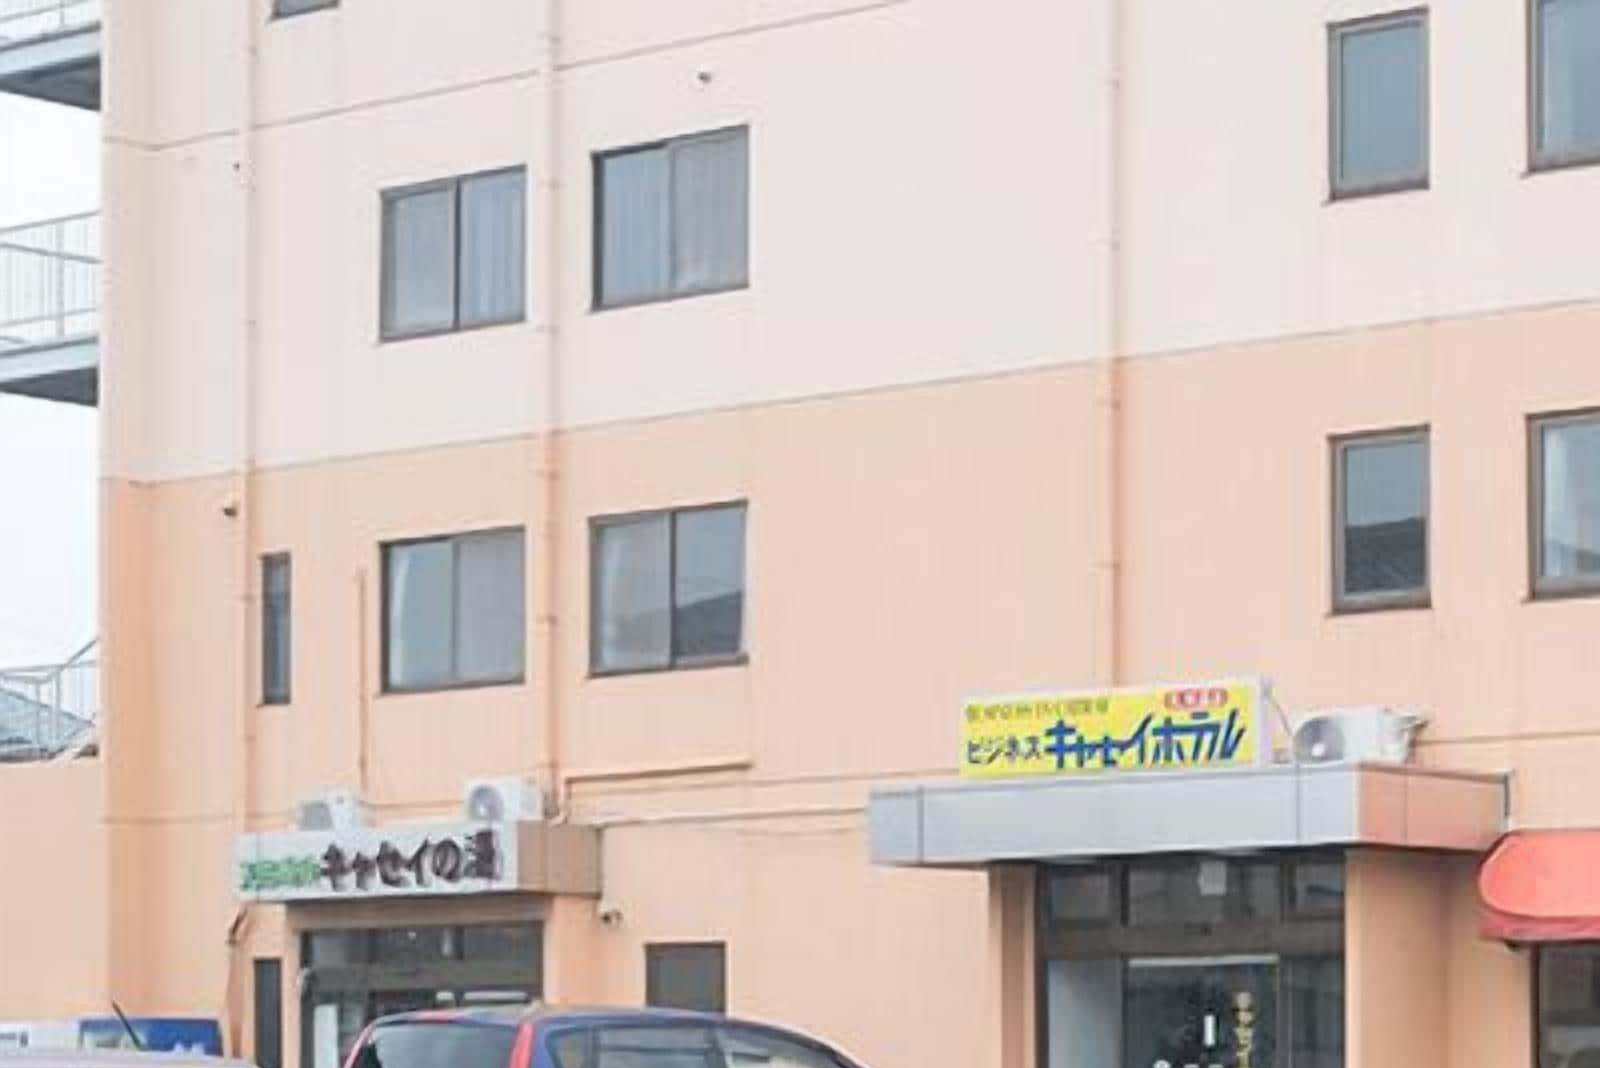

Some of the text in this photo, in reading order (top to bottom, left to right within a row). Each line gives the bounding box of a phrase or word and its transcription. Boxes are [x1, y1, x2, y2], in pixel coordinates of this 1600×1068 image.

[967, 736, 1043, 764] ビジネス
[1043, 708, 1246, 769] キャセイホテル
